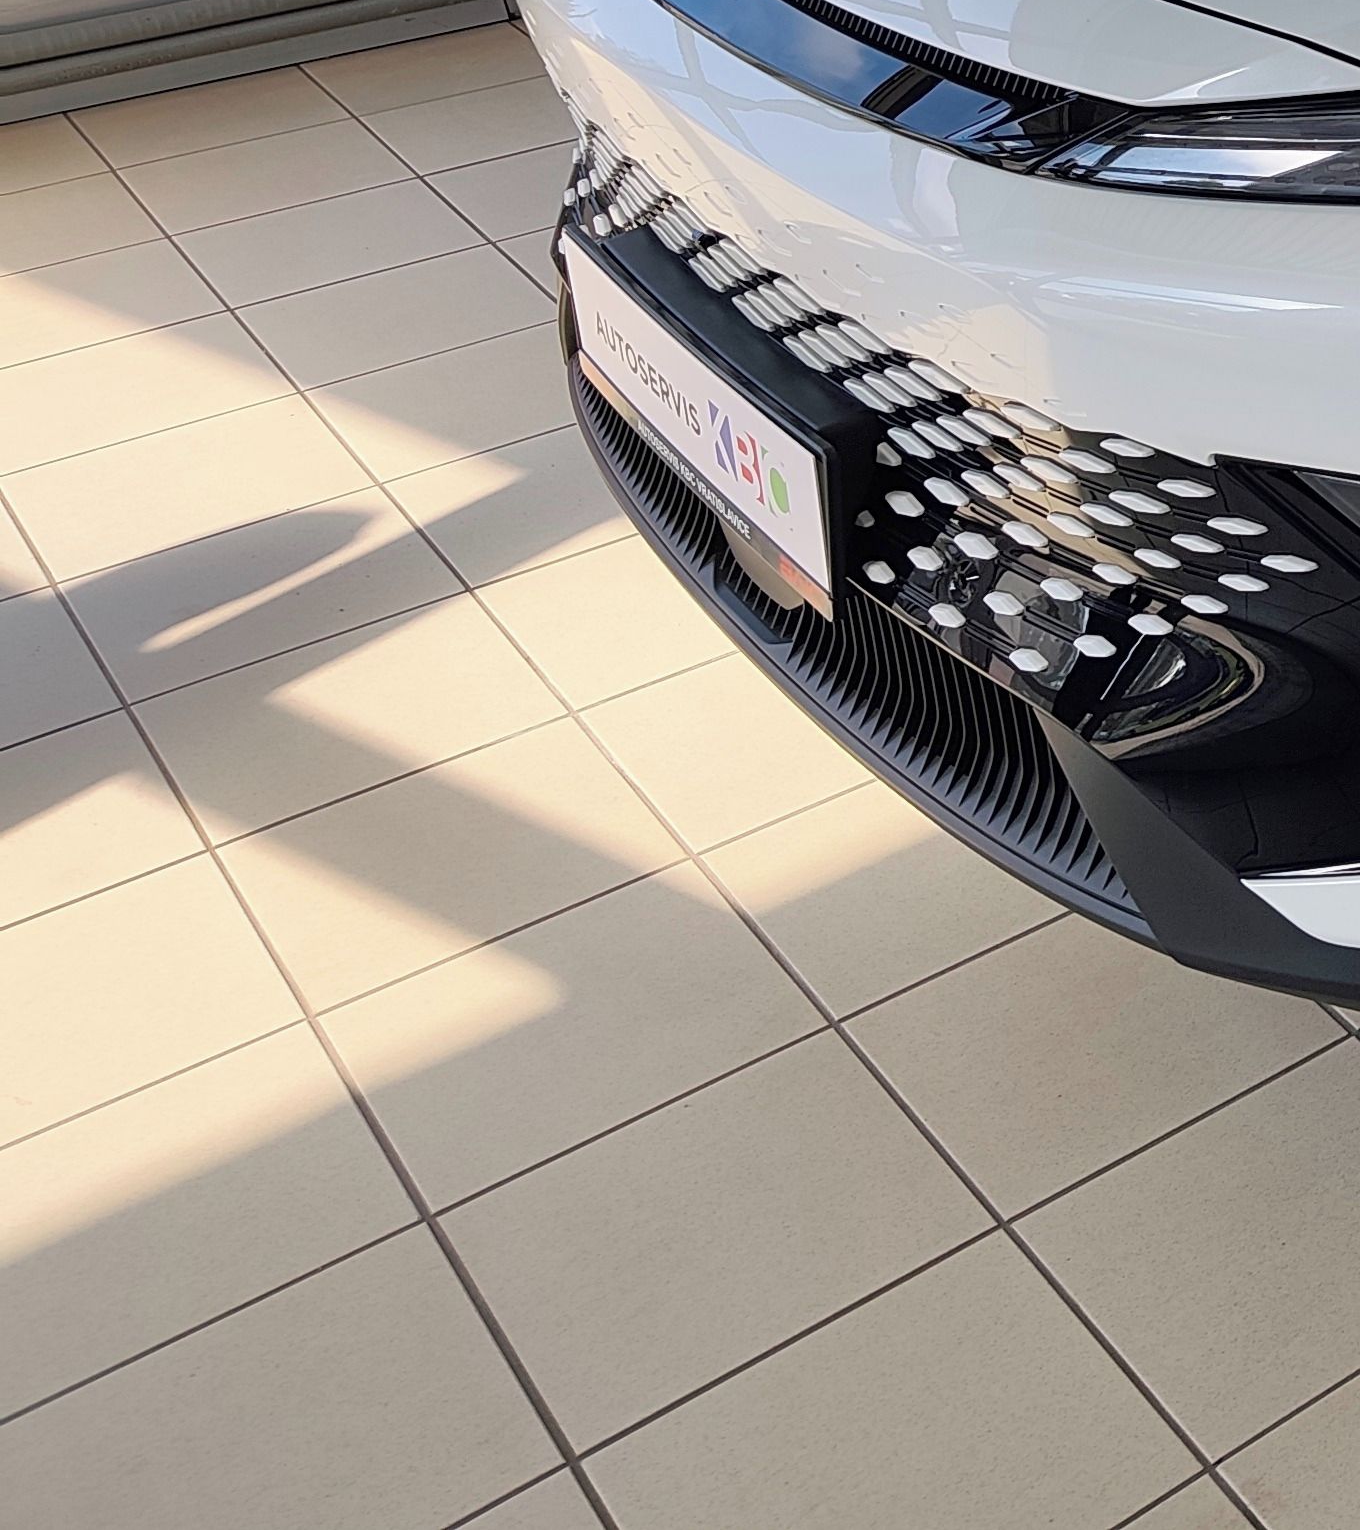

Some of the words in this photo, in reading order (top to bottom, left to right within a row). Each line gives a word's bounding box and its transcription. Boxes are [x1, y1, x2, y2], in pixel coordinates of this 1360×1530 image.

[596, 311, 702, 436] AUTOSERVIS
[638, 420, 680, 471] AUTOSERVIS
[680, 461, 696, 487] KBC
[696, 477, 752, 540] VRATISLAVICE
[707, 399, 792, 518] KBC
